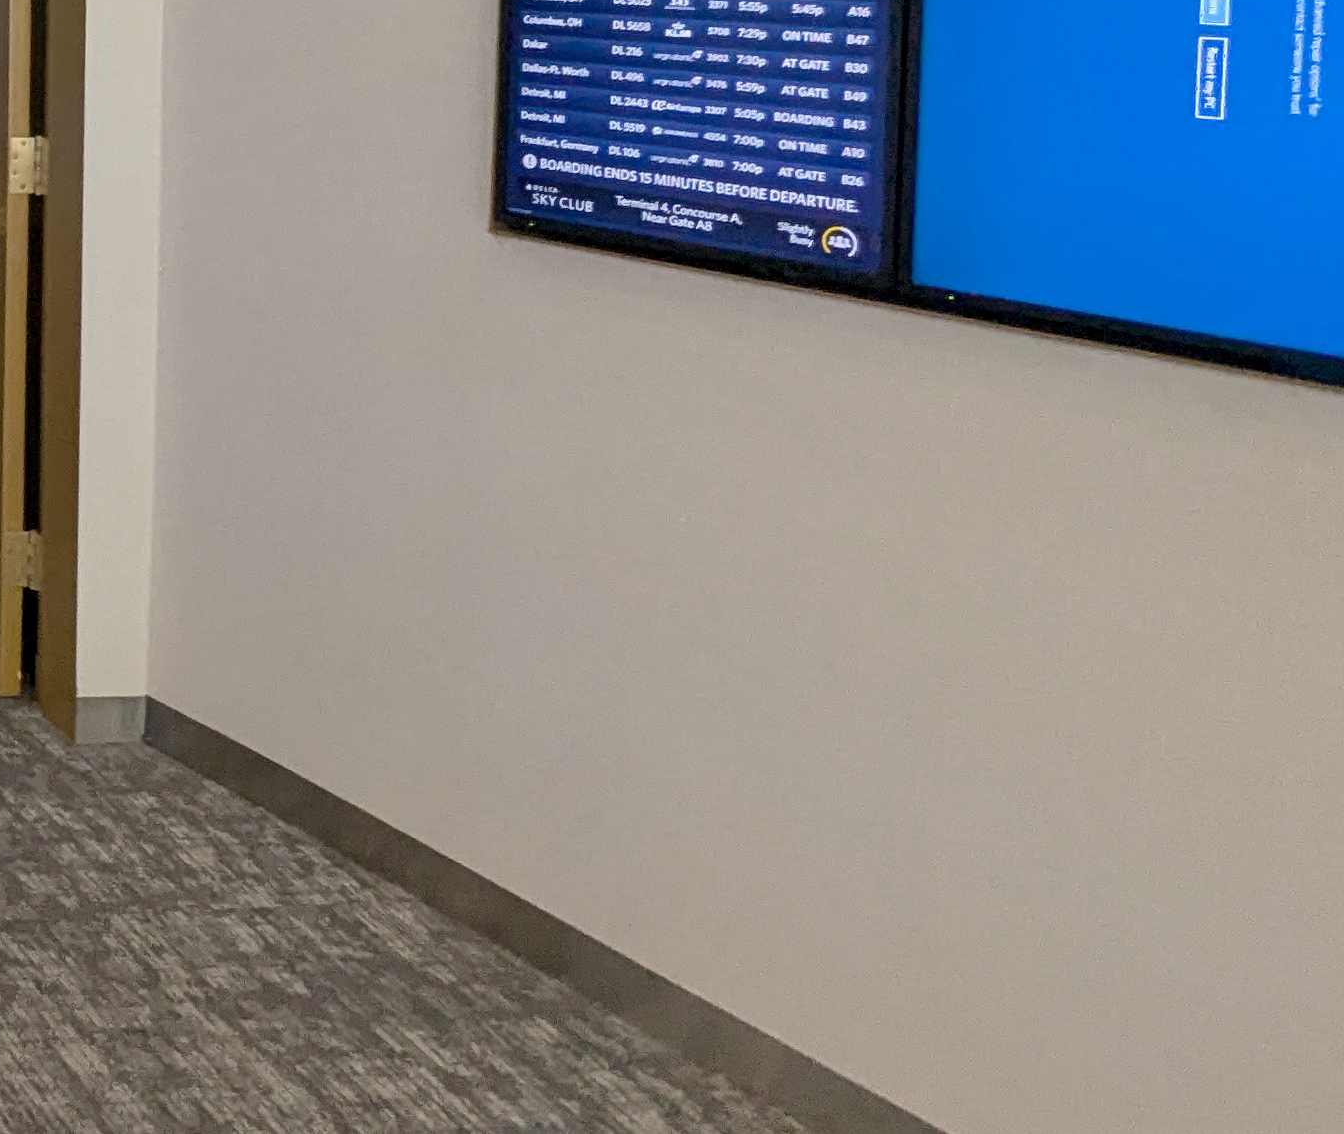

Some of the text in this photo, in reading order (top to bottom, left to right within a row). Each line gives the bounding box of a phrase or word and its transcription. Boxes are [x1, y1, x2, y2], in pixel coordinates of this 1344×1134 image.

[612, 20, 627, 30] DL
[782, 30, 801, 41] ON
[801, 31, 833, 44] TIME
[611, 45, 626, 55] DL
[781, 58, 798, 68] AT
[798, 58, 830, 71] GATE
[611, 70, 625, 81] DL
[781, 85, 798, 96] AT
[797, 86, 829, 99] GATE
[610, 95, 624, 106] DL
[773, 111, 835, 128] BOARDING
[609, 120, 623, 131] DL
[778, 139, 797, 151] ON
[797, 141, 828, 155] TIME
[608, 145, 622, 156] DL
[777, 167, 795, 177] AT
[794, 168, 826, 182] GATE
[540, 158, 859, 213] BOARDING ENDS 15 MINUTES BEFORE DEPARTURE.
[532, 193, 594, 213] SKY CLUB
[615, 195, 729, 222] Terminal 4, Concourse
[642, 211, 713, 232] Near Gate A8
